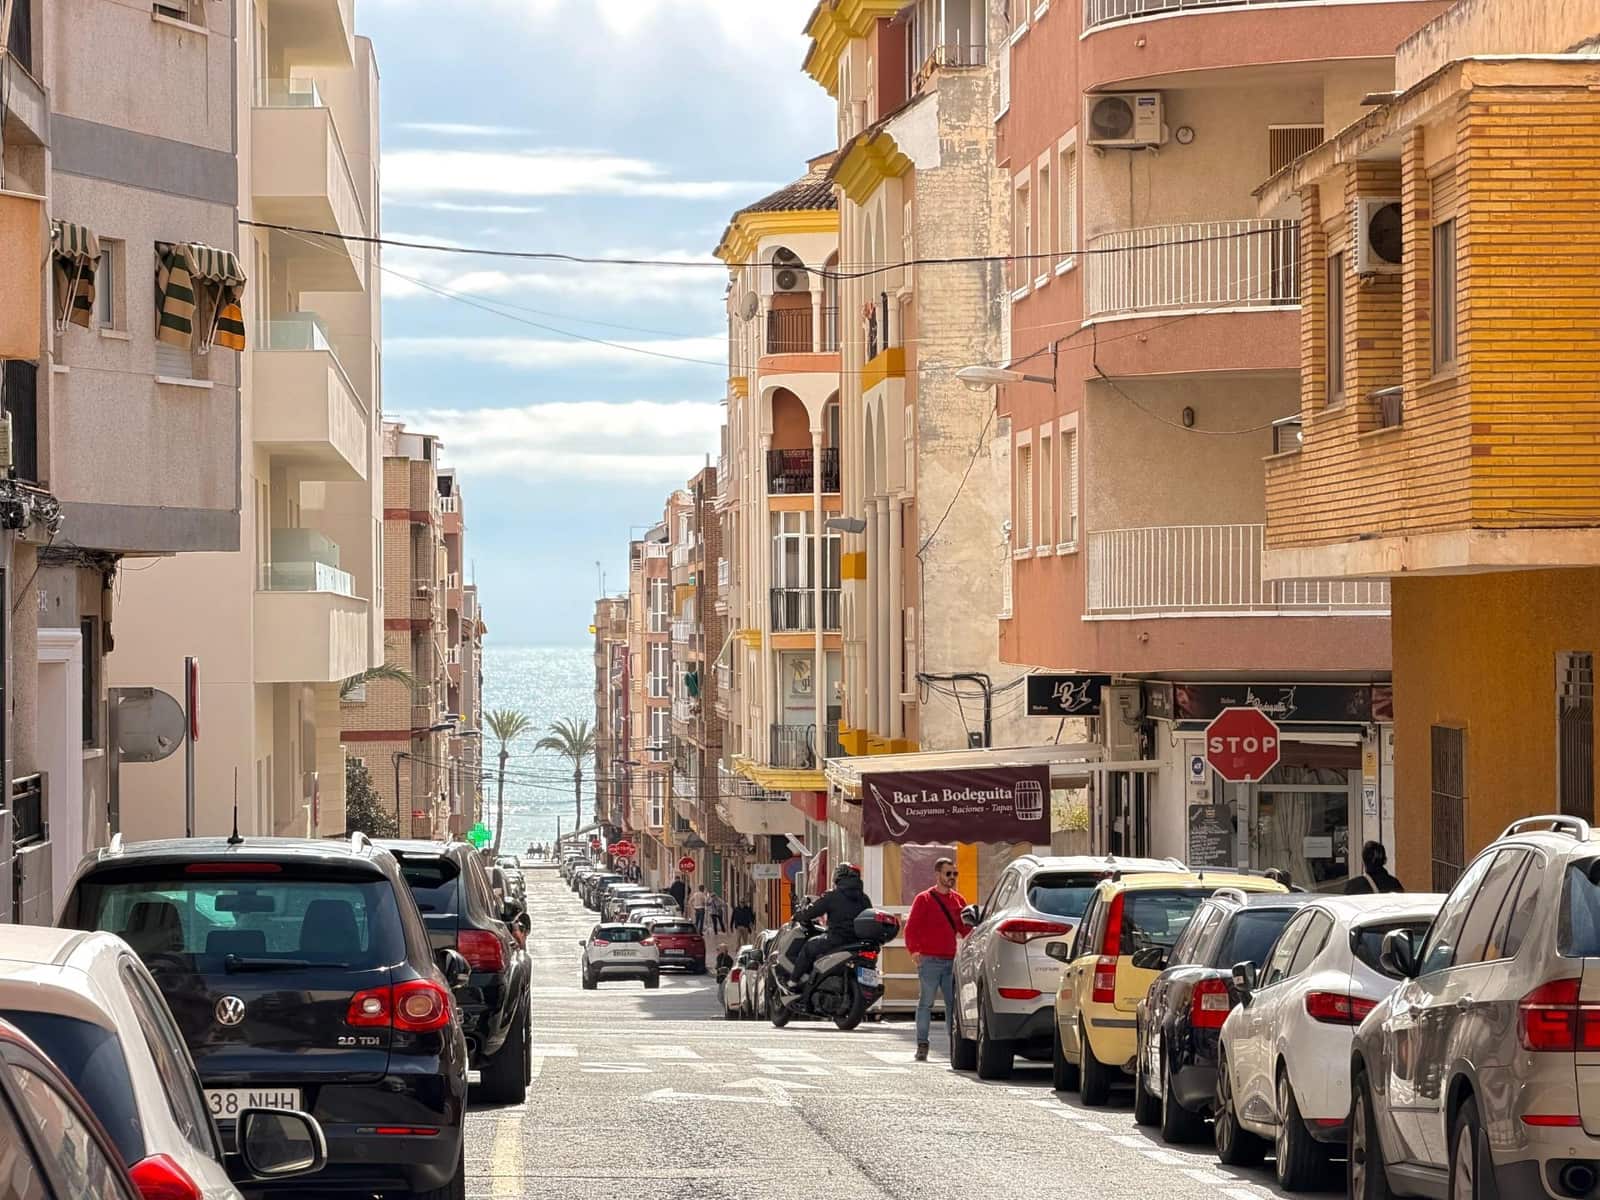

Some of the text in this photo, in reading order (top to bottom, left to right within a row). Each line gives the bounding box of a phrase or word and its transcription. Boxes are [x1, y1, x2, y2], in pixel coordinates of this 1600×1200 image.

[1209, 736, 1276, 754] STOP
[893, 787, 1013, 804] Bar La Bodeguita
[951, 805, 985, 815] Raciones
[991, 803, 1013, 814] Tapas
[337, 1036, 357, 1046] 2.0
[209, 1092, 295, 1115] 38 NHH
